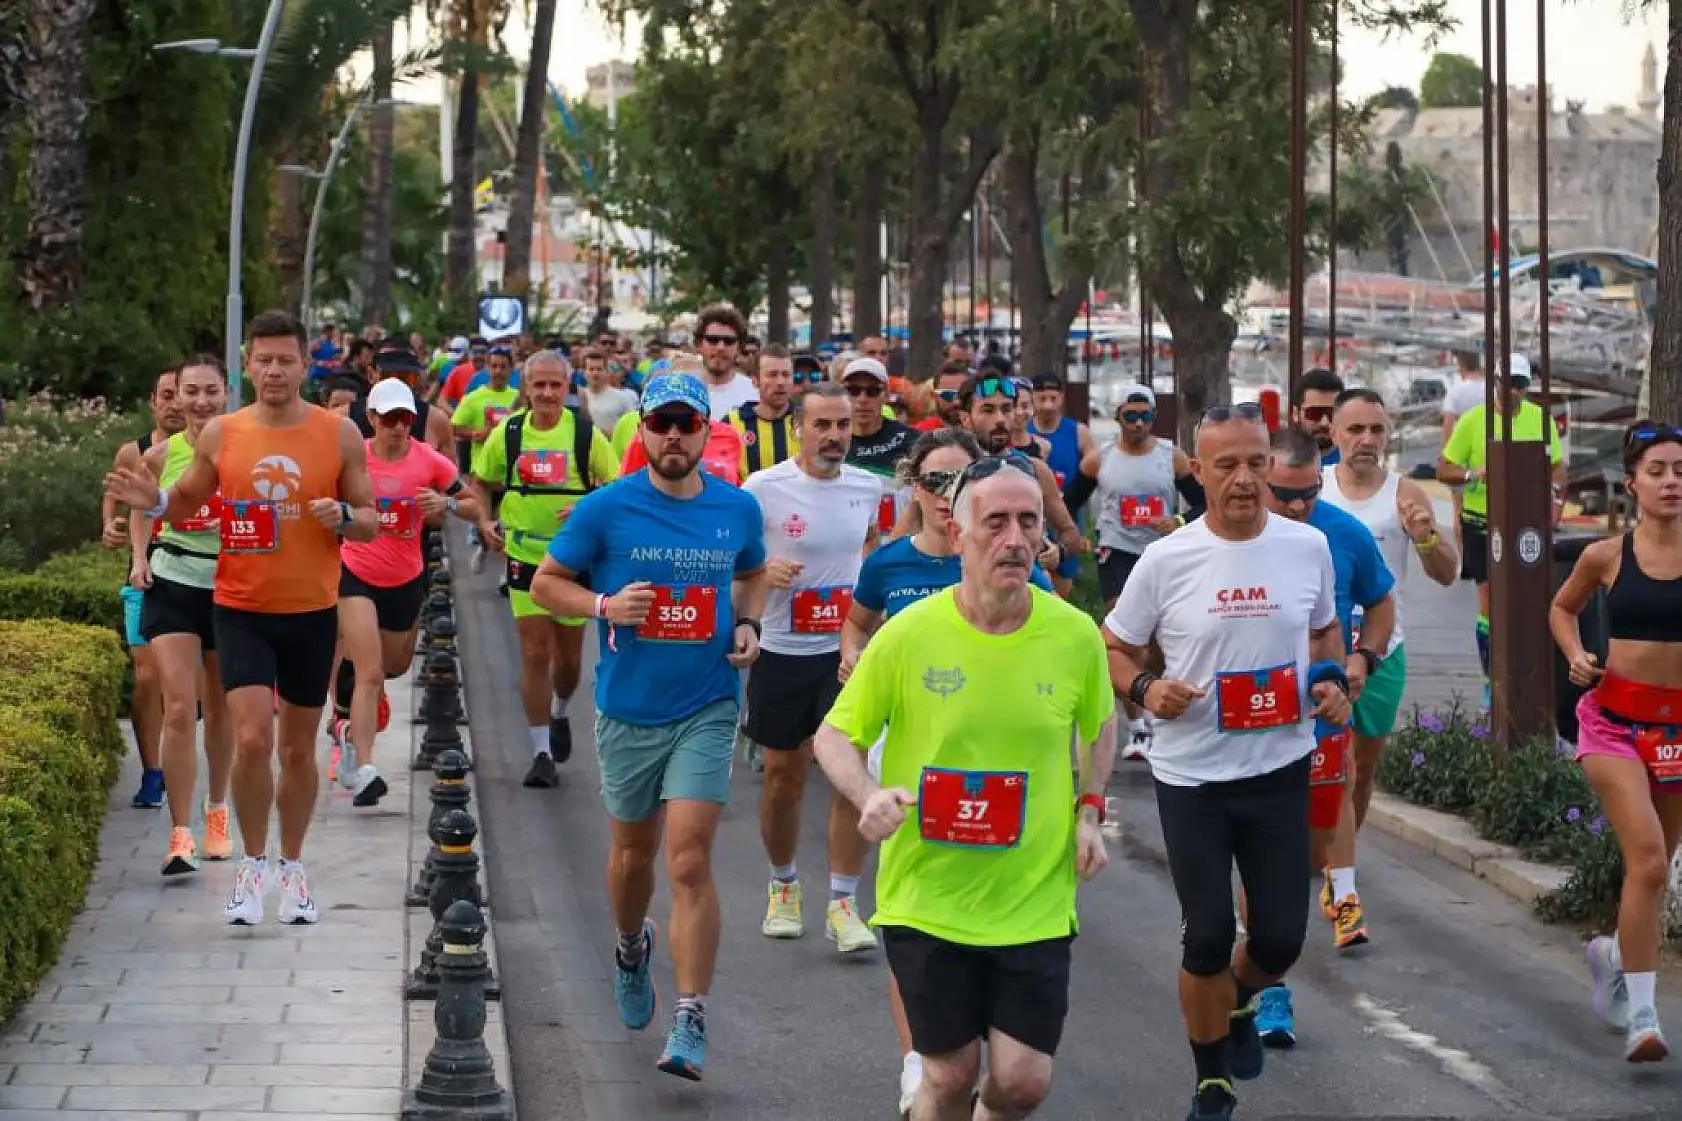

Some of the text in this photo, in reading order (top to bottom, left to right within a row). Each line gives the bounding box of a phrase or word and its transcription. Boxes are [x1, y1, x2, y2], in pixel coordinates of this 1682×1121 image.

[230, 520, 256, 534] 133
[1217, 587, 1267, 605] ÇAM
[659, 606, 697, 622] 350
[812, 605, 838, 619] 341
[1250, 692, 1276, 710] 93
[1655, 744, 1682, 760] 107
[957, 800, 989, 820] 37
